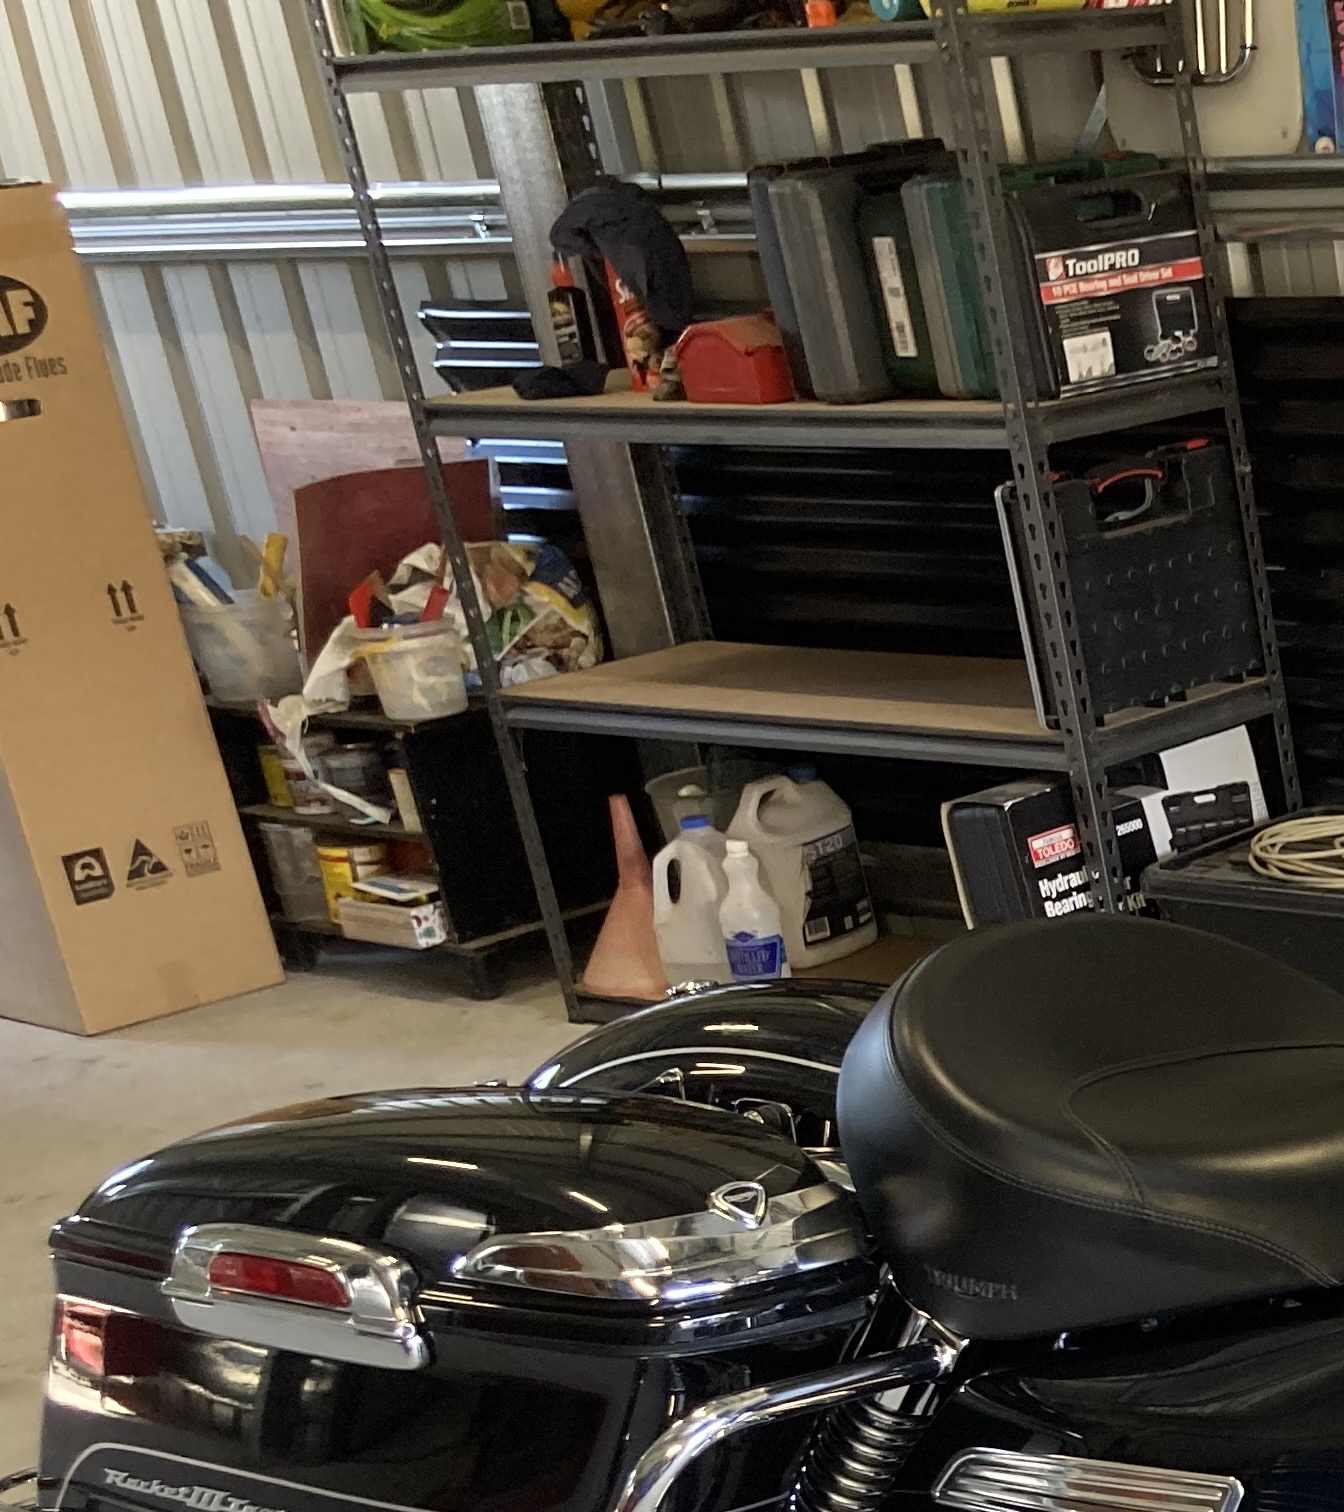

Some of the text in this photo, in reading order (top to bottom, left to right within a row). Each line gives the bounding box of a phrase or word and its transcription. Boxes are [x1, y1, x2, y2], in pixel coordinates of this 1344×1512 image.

[1065, 248, 1140, 278] ToolPRO
[1034, 840, 1075, 861] TOLEDO
[1044, 891, 1095, 918] Bearing
[923, 1262, 1018, 1300] TRIUMPH
